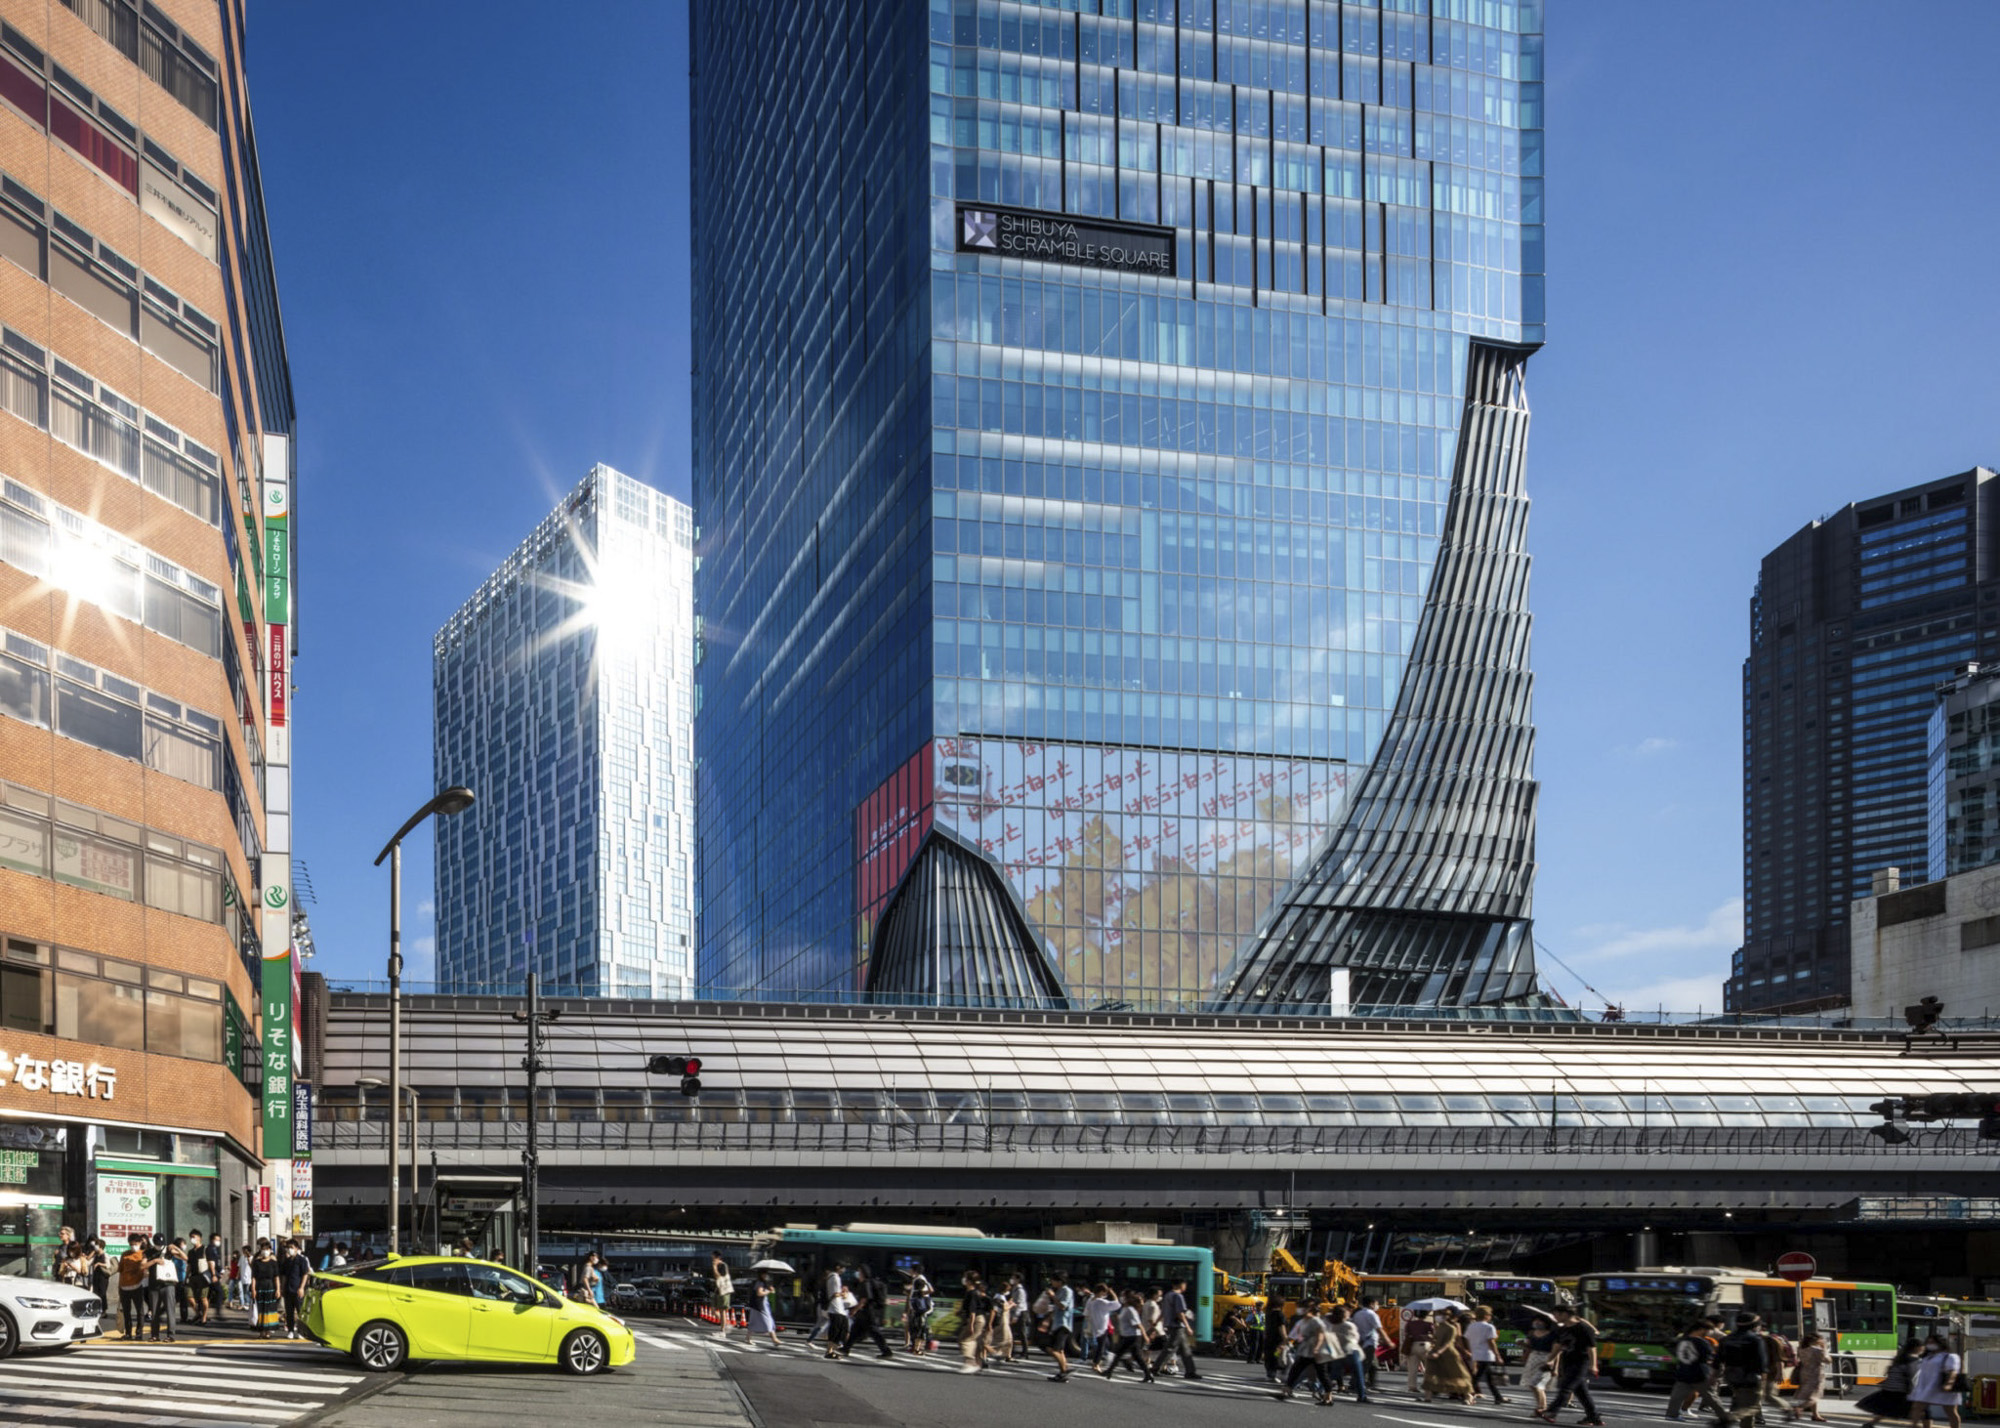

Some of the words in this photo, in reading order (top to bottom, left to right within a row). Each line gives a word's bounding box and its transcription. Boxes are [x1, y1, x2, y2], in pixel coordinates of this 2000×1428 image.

[1001, 215, 1079, 239] SHIBUYA
[1001, 233, 1095, 260] SCRAMBLE
[1100, 246, 1170, 270] SQUARE
[273, 635, 282, 698] 三井のリハウス
[268, 1002, 287, 1119] りそな銀行
[296, 1089, 309, 1151] 児玉歯科医院
